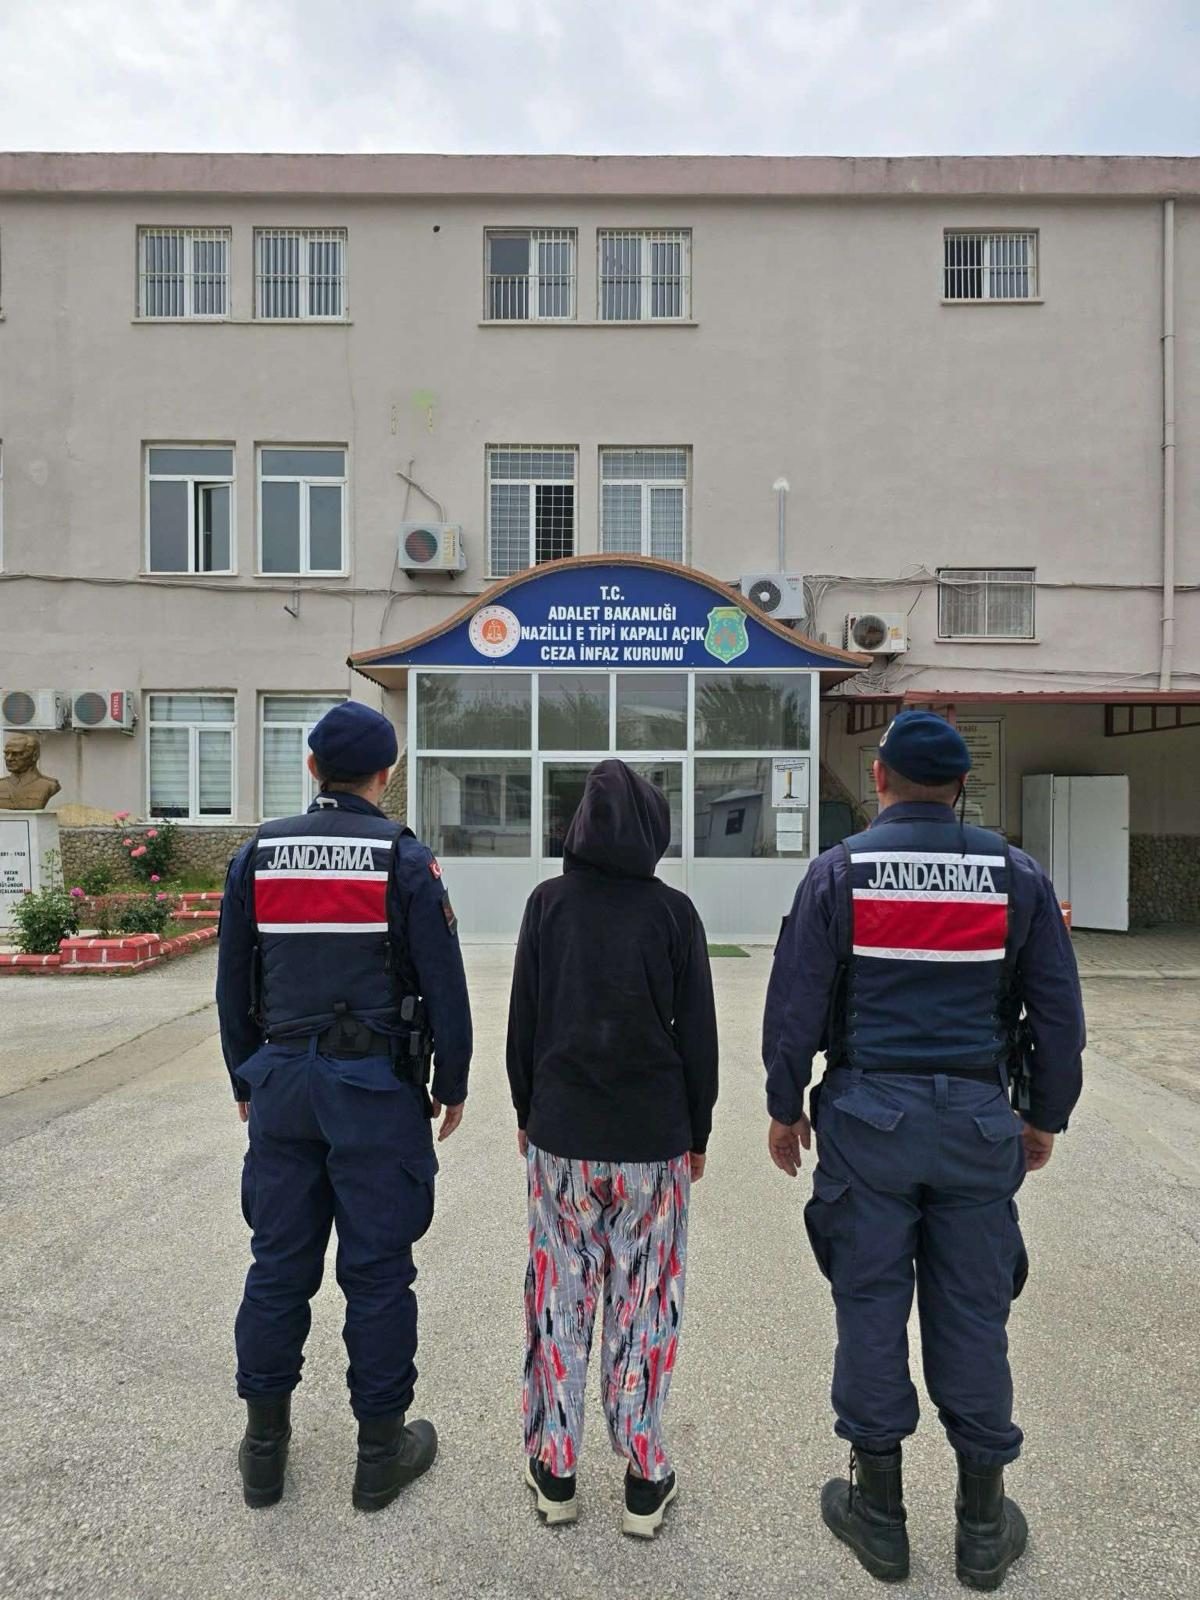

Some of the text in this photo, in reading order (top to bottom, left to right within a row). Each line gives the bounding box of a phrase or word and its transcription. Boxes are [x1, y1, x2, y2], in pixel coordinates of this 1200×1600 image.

[600, 586, 625, 601] T.C.
[548, 603, 677, 621] ADALET BAKANLIĞI
[521, 623, 705, 645] NAZİLLİ E TİPİ KAPALI AÇIK
[541, 643, 684, 662] CEZA İNFAZ KURUMU
[267, 845, 375, 871] JANDARMA
[868, 861, 997, 893] JANDARMA
